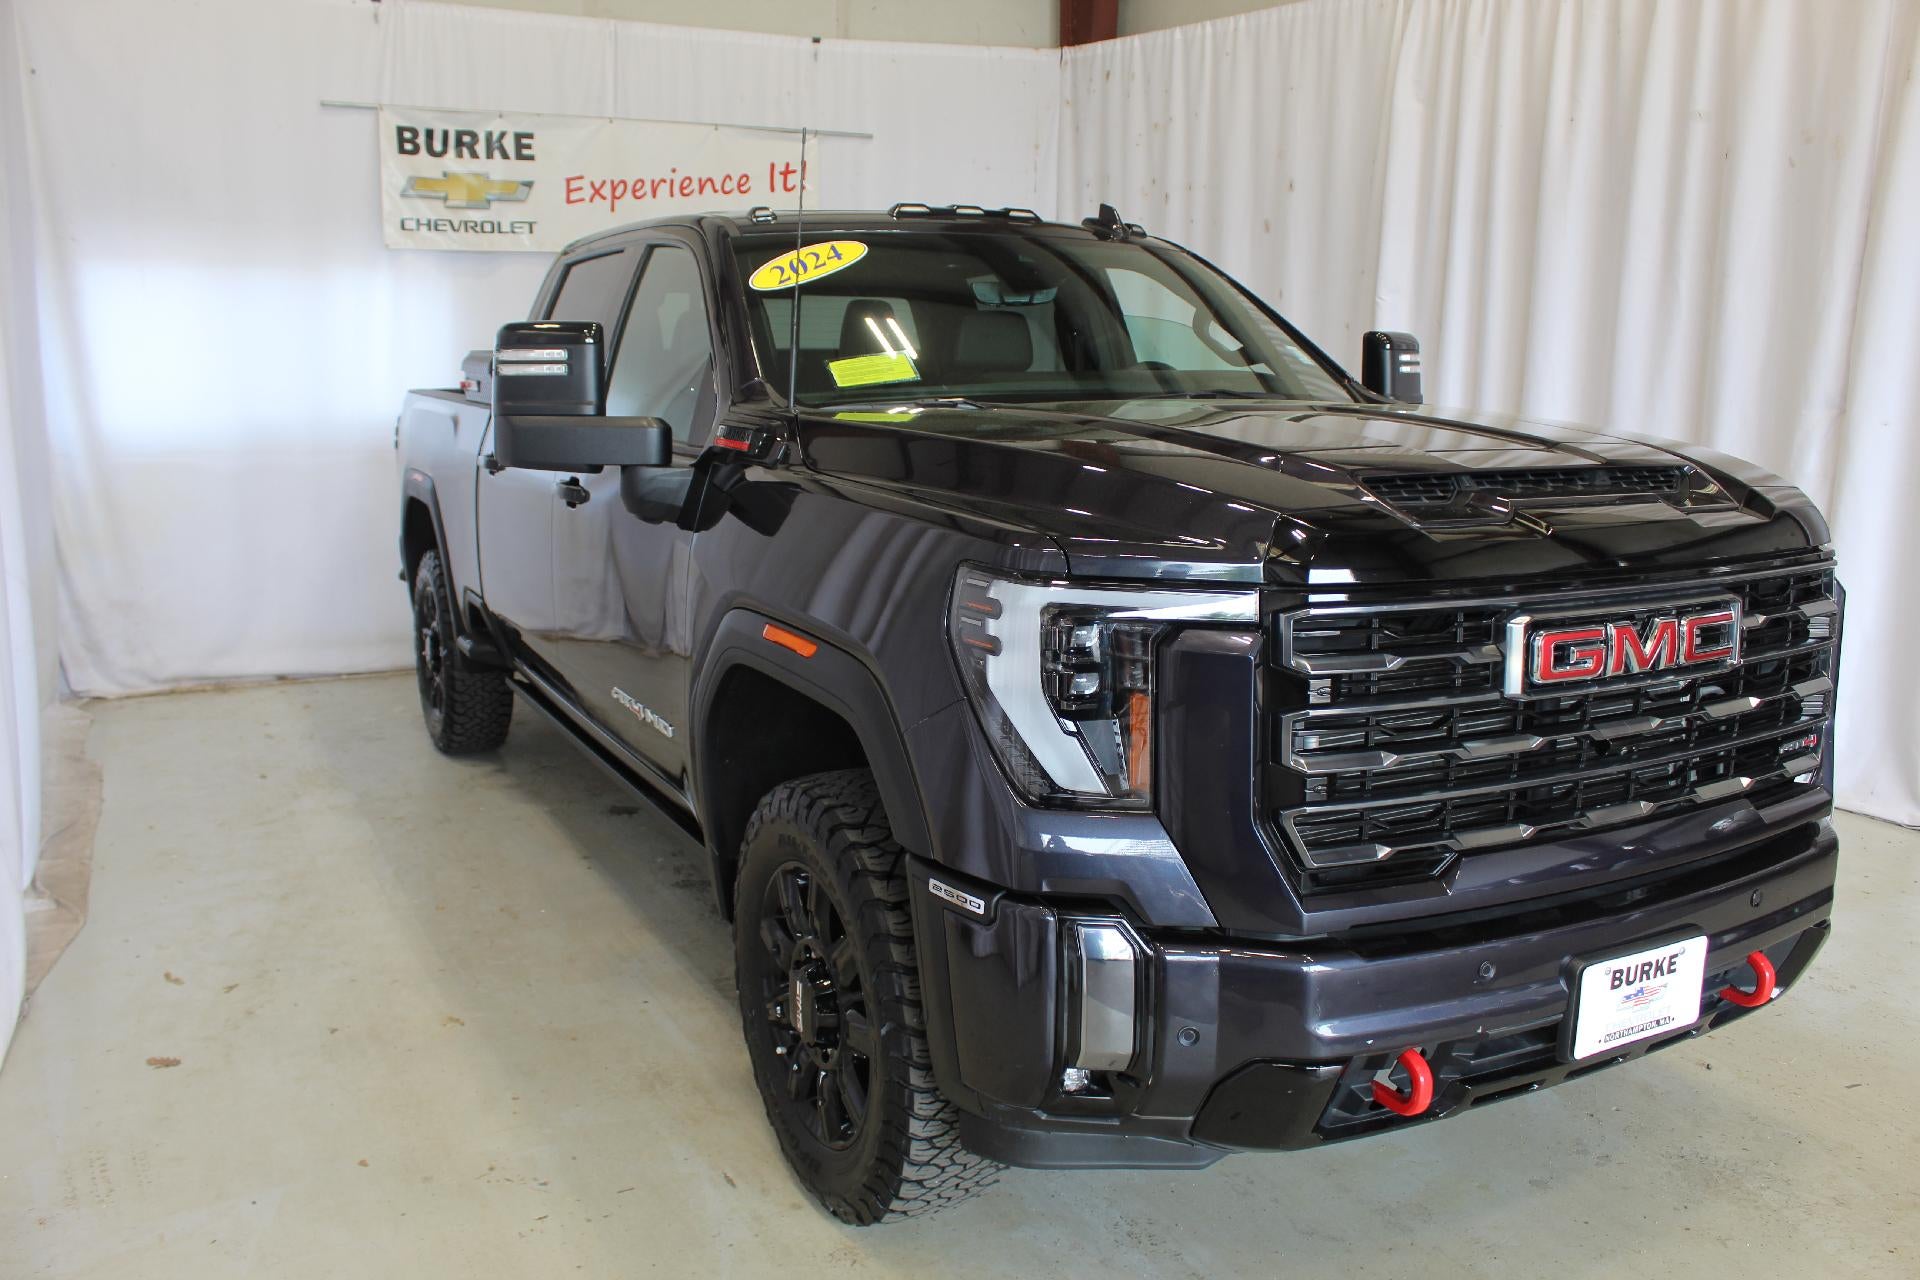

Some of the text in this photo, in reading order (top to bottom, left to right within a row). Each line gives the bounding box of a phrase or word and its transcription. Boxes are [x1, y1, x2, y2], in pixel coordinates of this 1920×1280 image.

[396, 126, 536, 160] BURKE
[564, 166, 751, 213] Experience
[400, 217, 538, 235] CHEVROLET
[770, 244, 842, 285] 2024
[1530, 610, 1738, 684] GMC
[932, 884, 981, 910] 2500
[1610, 953, 1679, 990] BURKE
